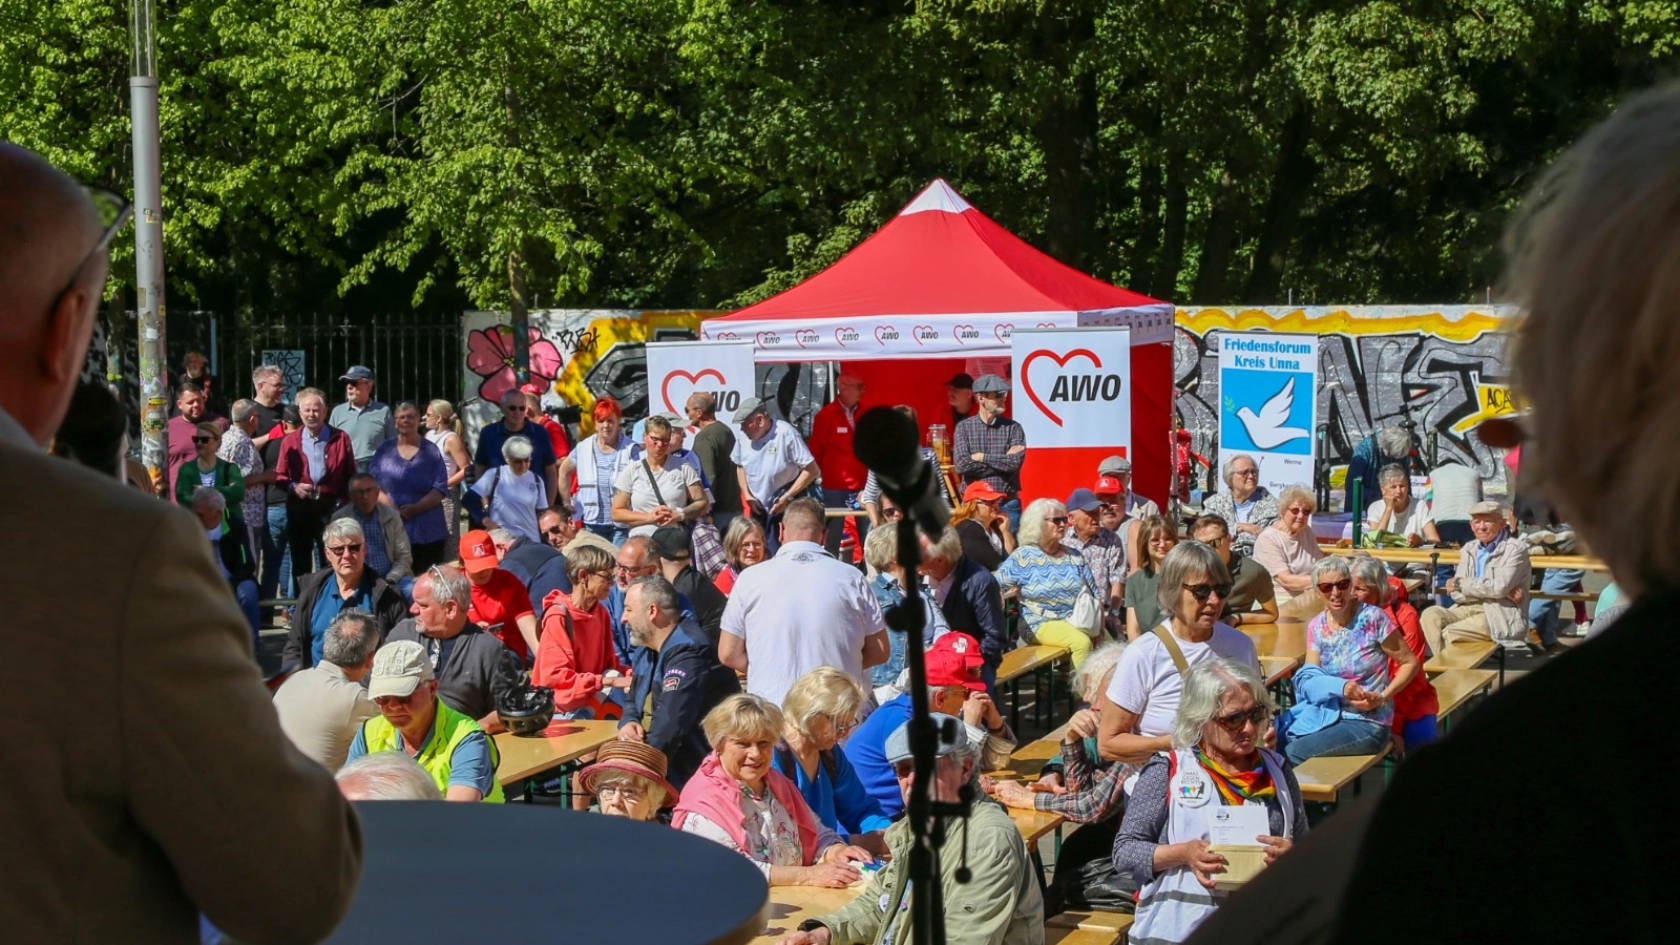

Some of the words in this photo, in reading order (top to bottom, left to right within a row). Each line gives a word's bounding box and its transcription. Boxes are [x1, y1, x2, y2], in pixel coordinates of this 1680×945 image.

[802, 335, 820, 343] AWO
[841, 333, 860, 342] AWO
[881, 332, 900, 340] AWO
[921, 331, 939, 340] AWO
[961, 330, 980, 339] AWO
[763, 336, 780, 344] AWO
[1224, 338, 1311, 354] Friedensforum
[1234, 355, 1266, 369] Kreis
[1269, 357, 1300, 370] Unna
[1049, 374, 1122, 402] AWO
[692, 390, 741, 412] WO
